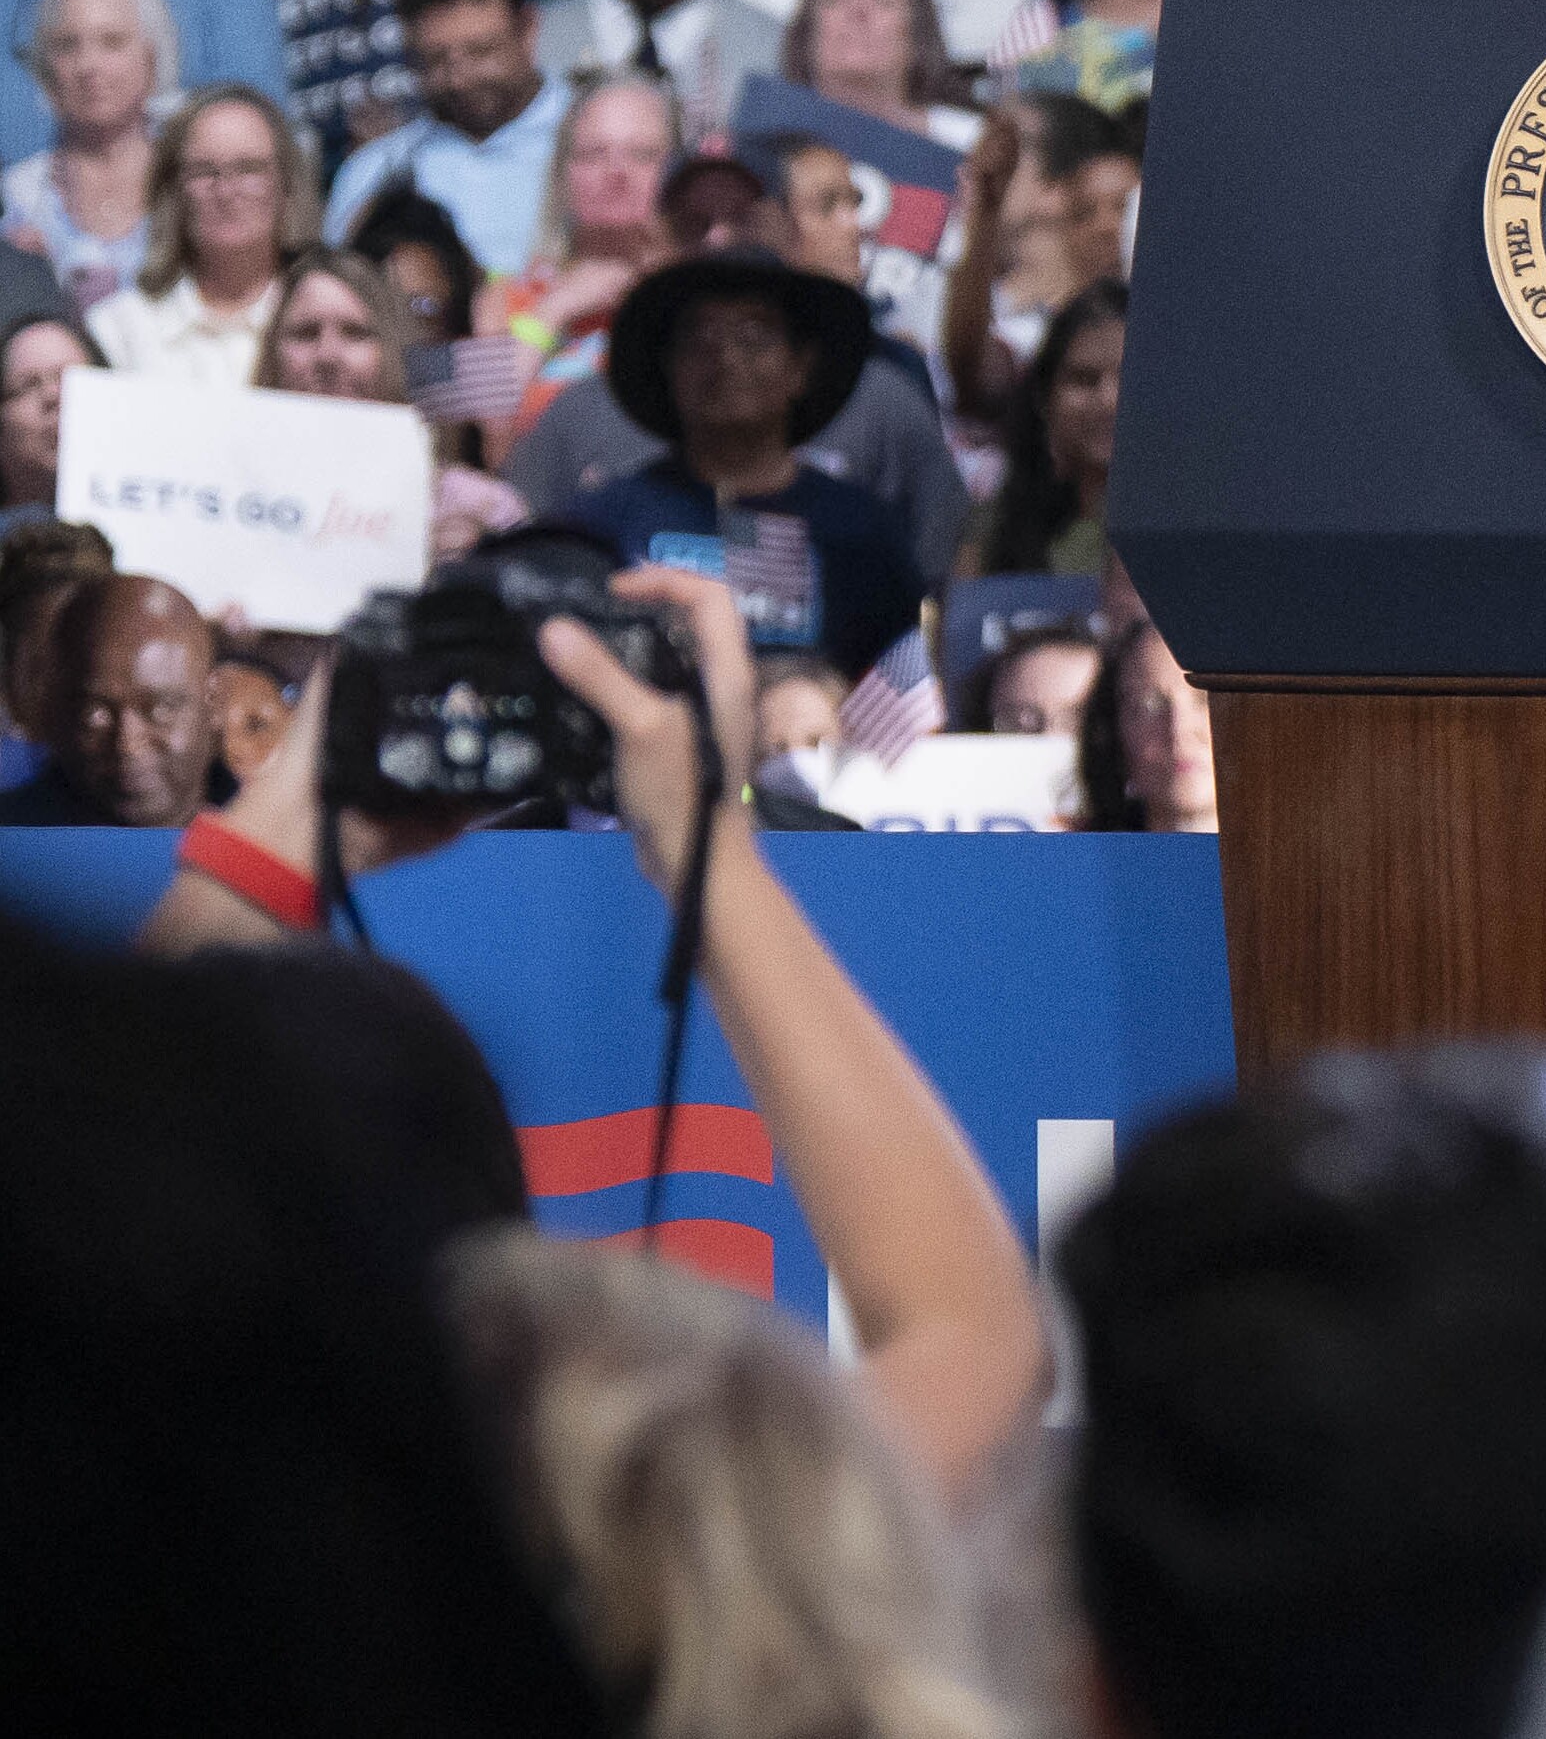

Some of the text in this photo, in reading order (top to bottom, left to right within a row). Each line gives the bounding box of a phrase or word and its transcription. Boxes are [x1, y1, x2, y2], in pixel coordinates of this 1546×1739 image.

[1505, 217, 1537, 277] THE
[90, 474, 223, 521] LET'S
[236, 491, 308, 533] GO
